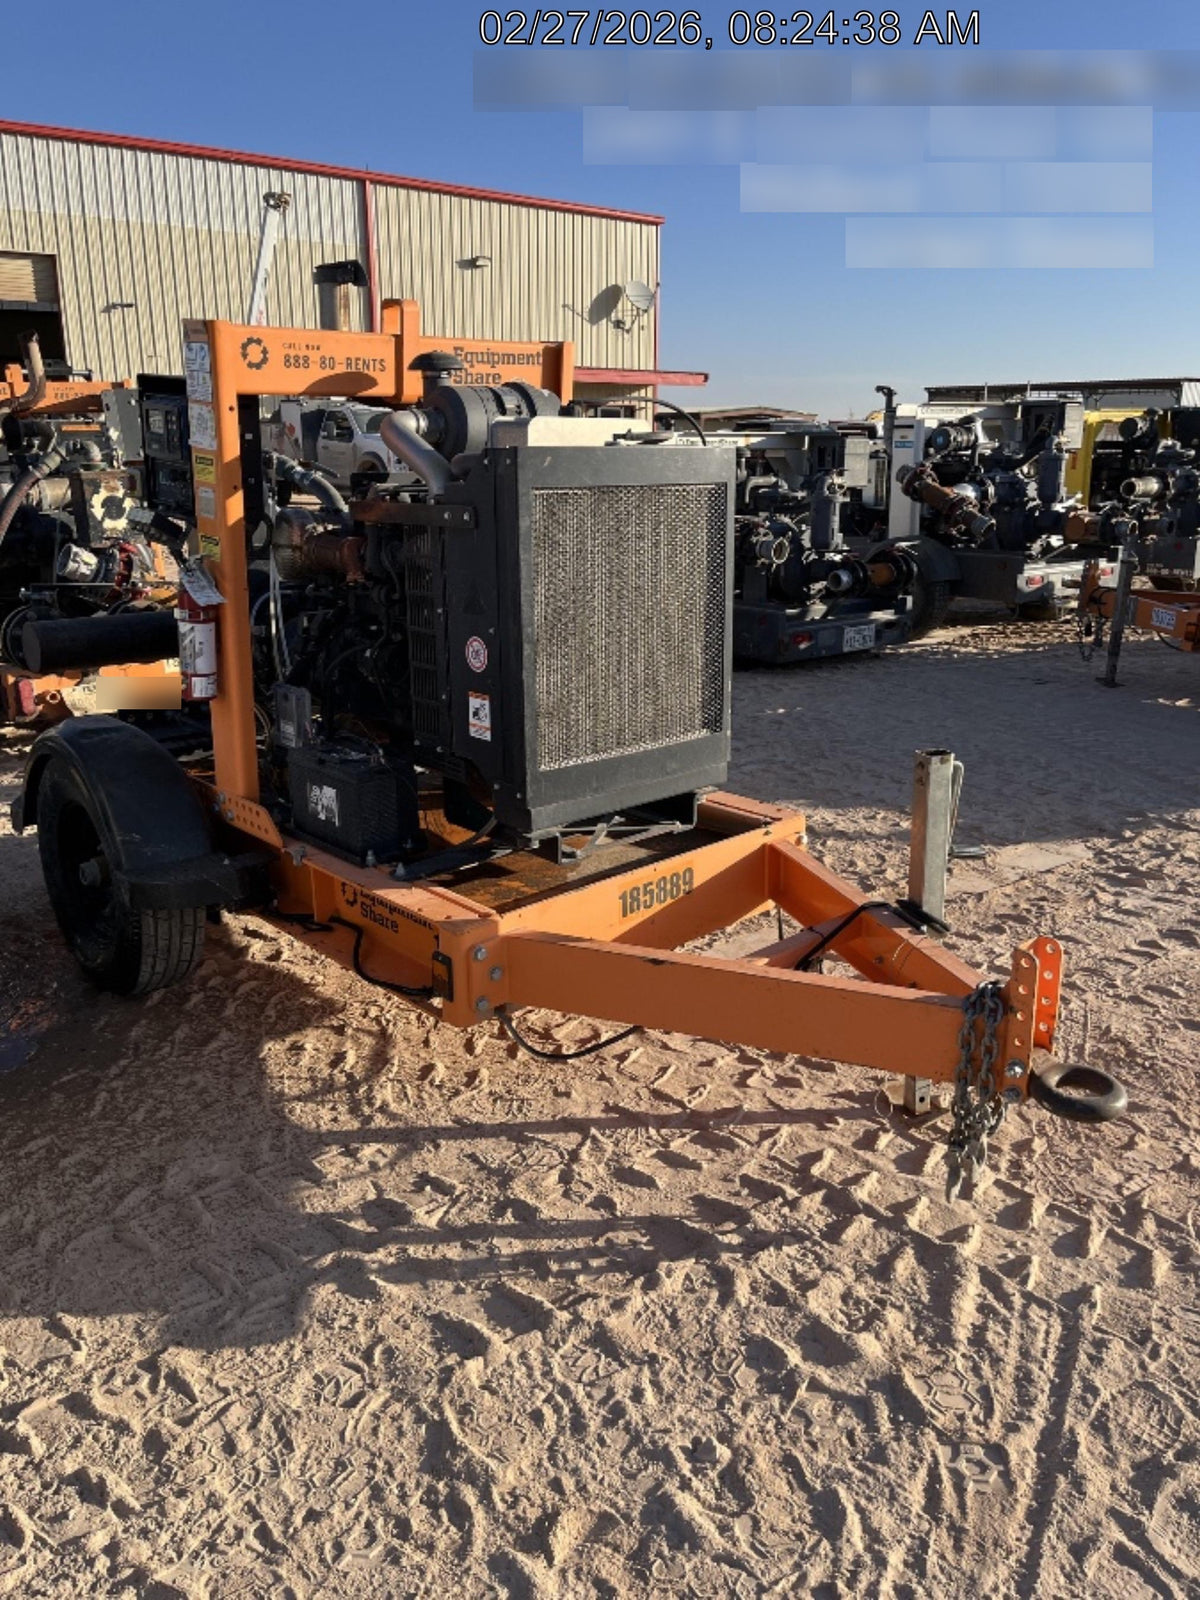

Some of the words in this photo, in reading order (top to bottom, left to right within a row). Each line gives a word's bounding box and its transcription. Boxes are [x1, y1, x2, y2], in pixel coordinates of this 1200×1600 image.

[284, 353, 386, 372] 888-80-RENTS
[453, 346, 542, 368] Equipment
[453, 367, 501, 385] Share
[619, 867, 694, 918] 185889
[361, 901, 399, 934] Share
